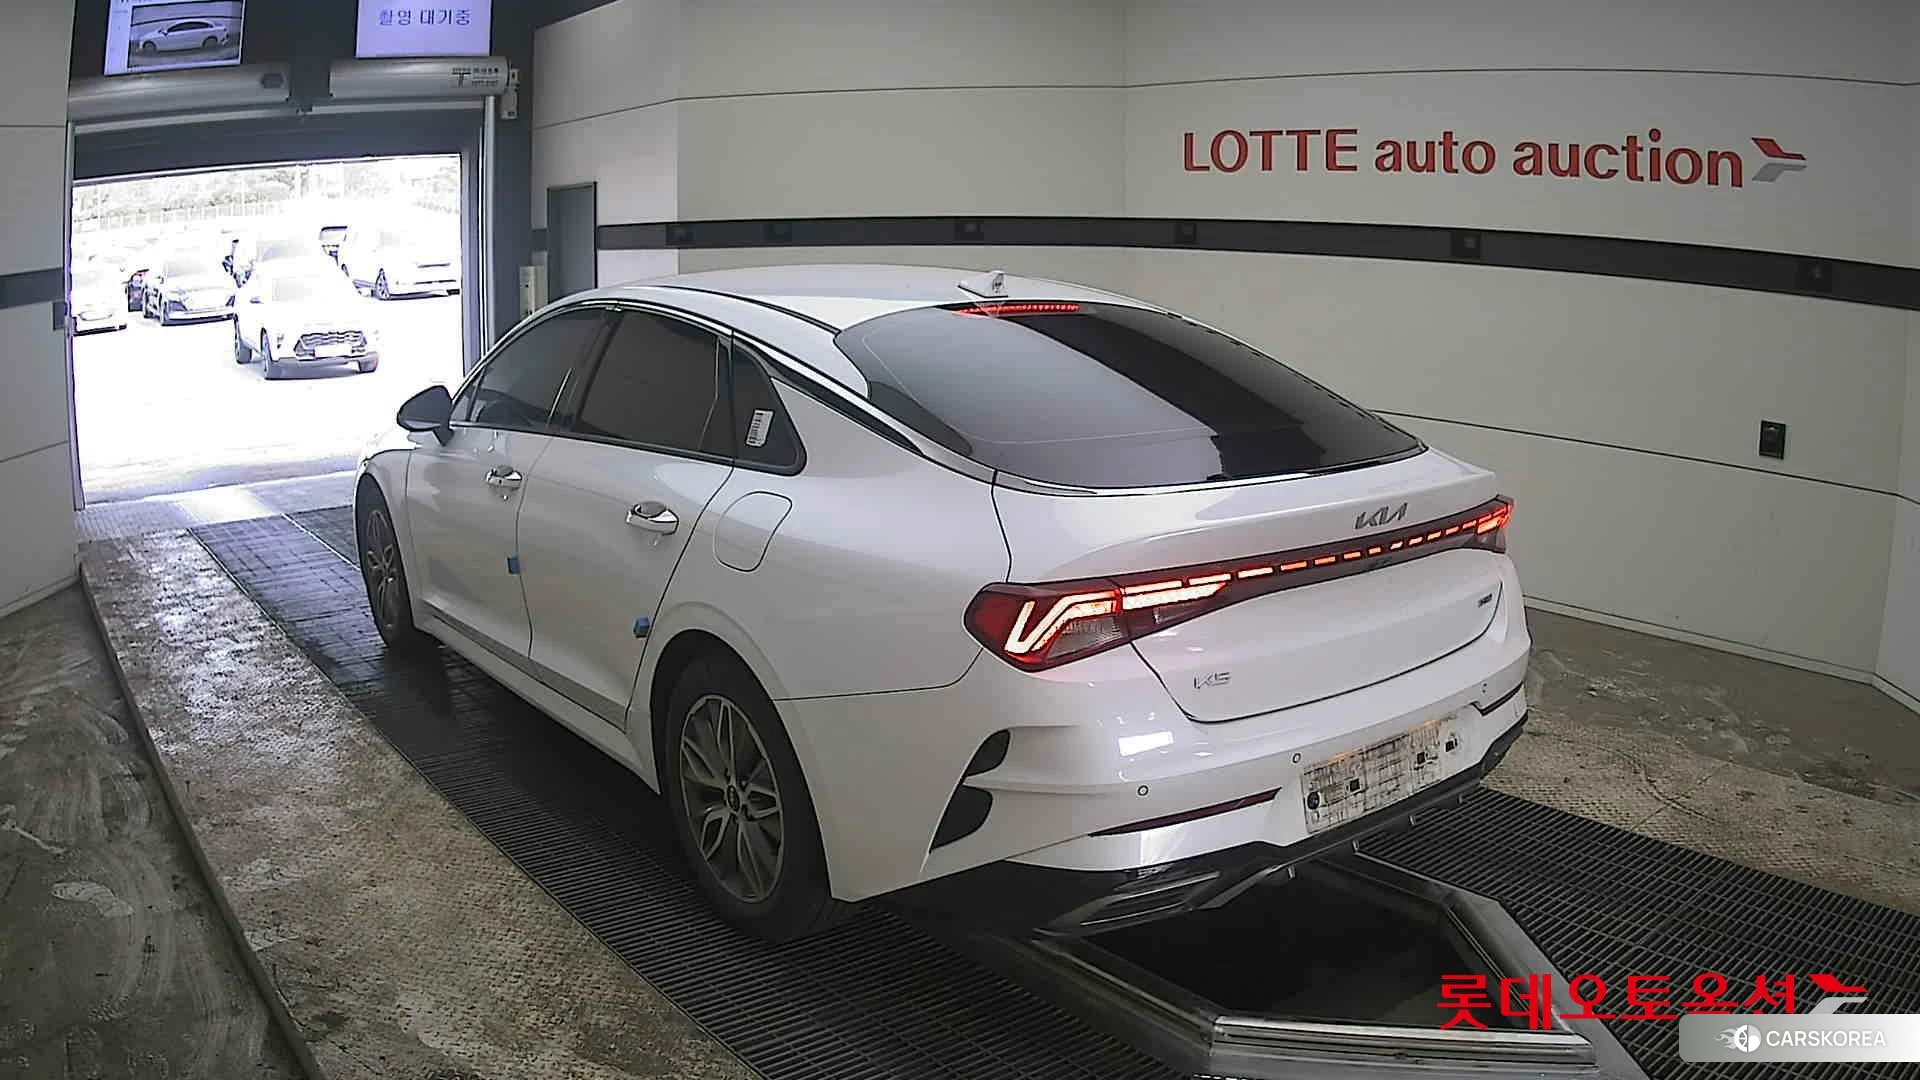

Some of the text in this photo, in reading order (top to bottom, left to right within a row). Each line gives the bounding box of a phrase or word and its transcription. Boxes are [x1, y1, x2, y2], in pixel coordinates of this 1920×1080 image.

[420, 8, 471, 26] 대기중
[1184, 128, 1743, 188] LOTTE auto auction
[1193, 671, 1231, 689] K5
